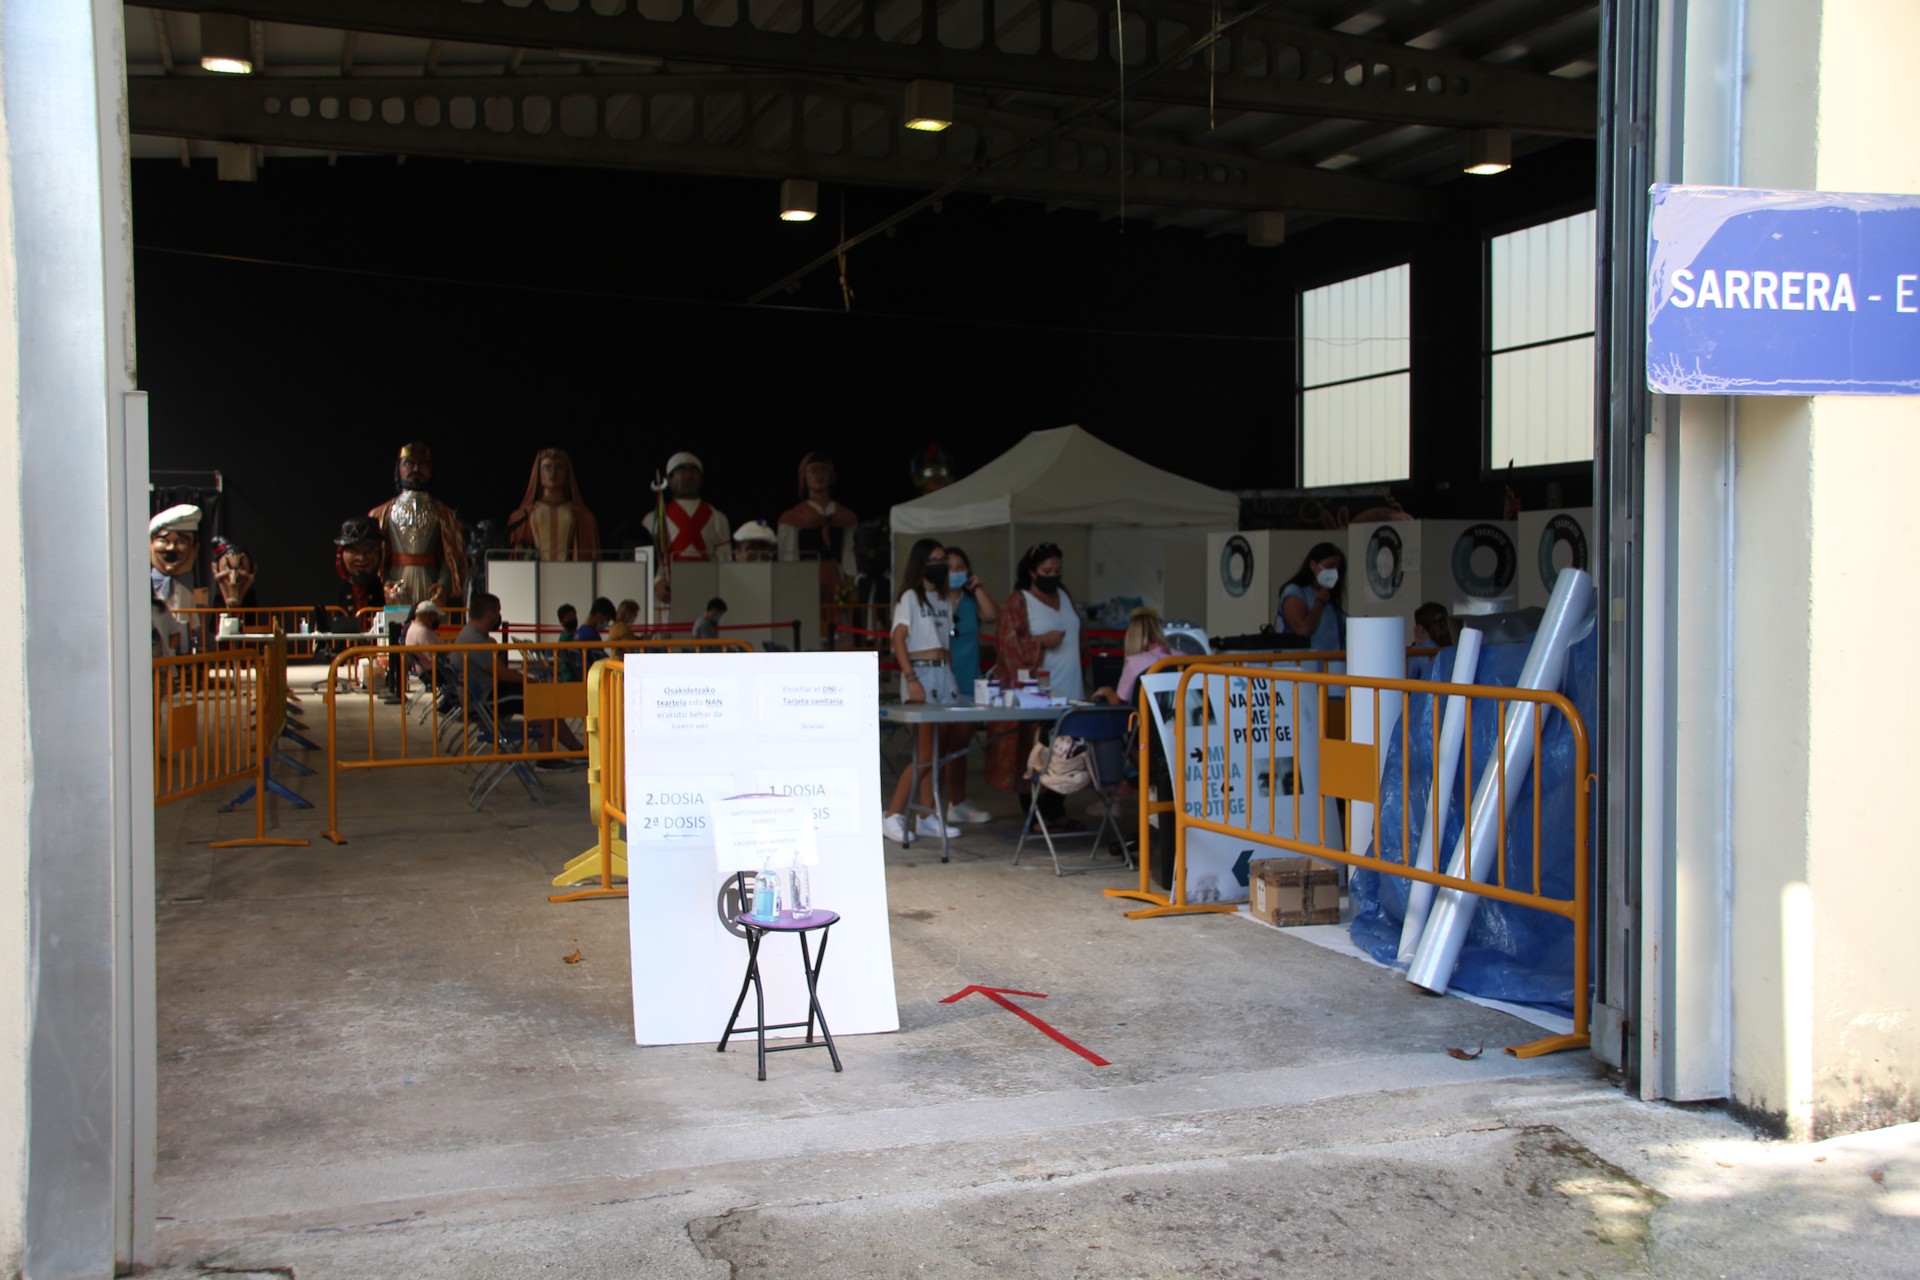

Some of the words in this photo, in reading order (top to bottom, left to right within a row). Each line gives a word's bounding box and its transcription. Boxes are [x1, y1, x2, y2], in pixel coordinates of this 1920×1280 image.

[1670, 269, 1856, 312] SARRERA
[657, 699, 687, 707] txartela
[705, 698, 723, 706] NAN
[783, 698, 809, 706] Tarjeta
[1228, 692, 1285, 708] VAUA
[1233, 726, 1292, 743] POTGE
[1185, 763, 1241, 782] VAUA
[1185, 798, 1246, 817] PROTGE
[664, 815, 707, 829] DOSIS
